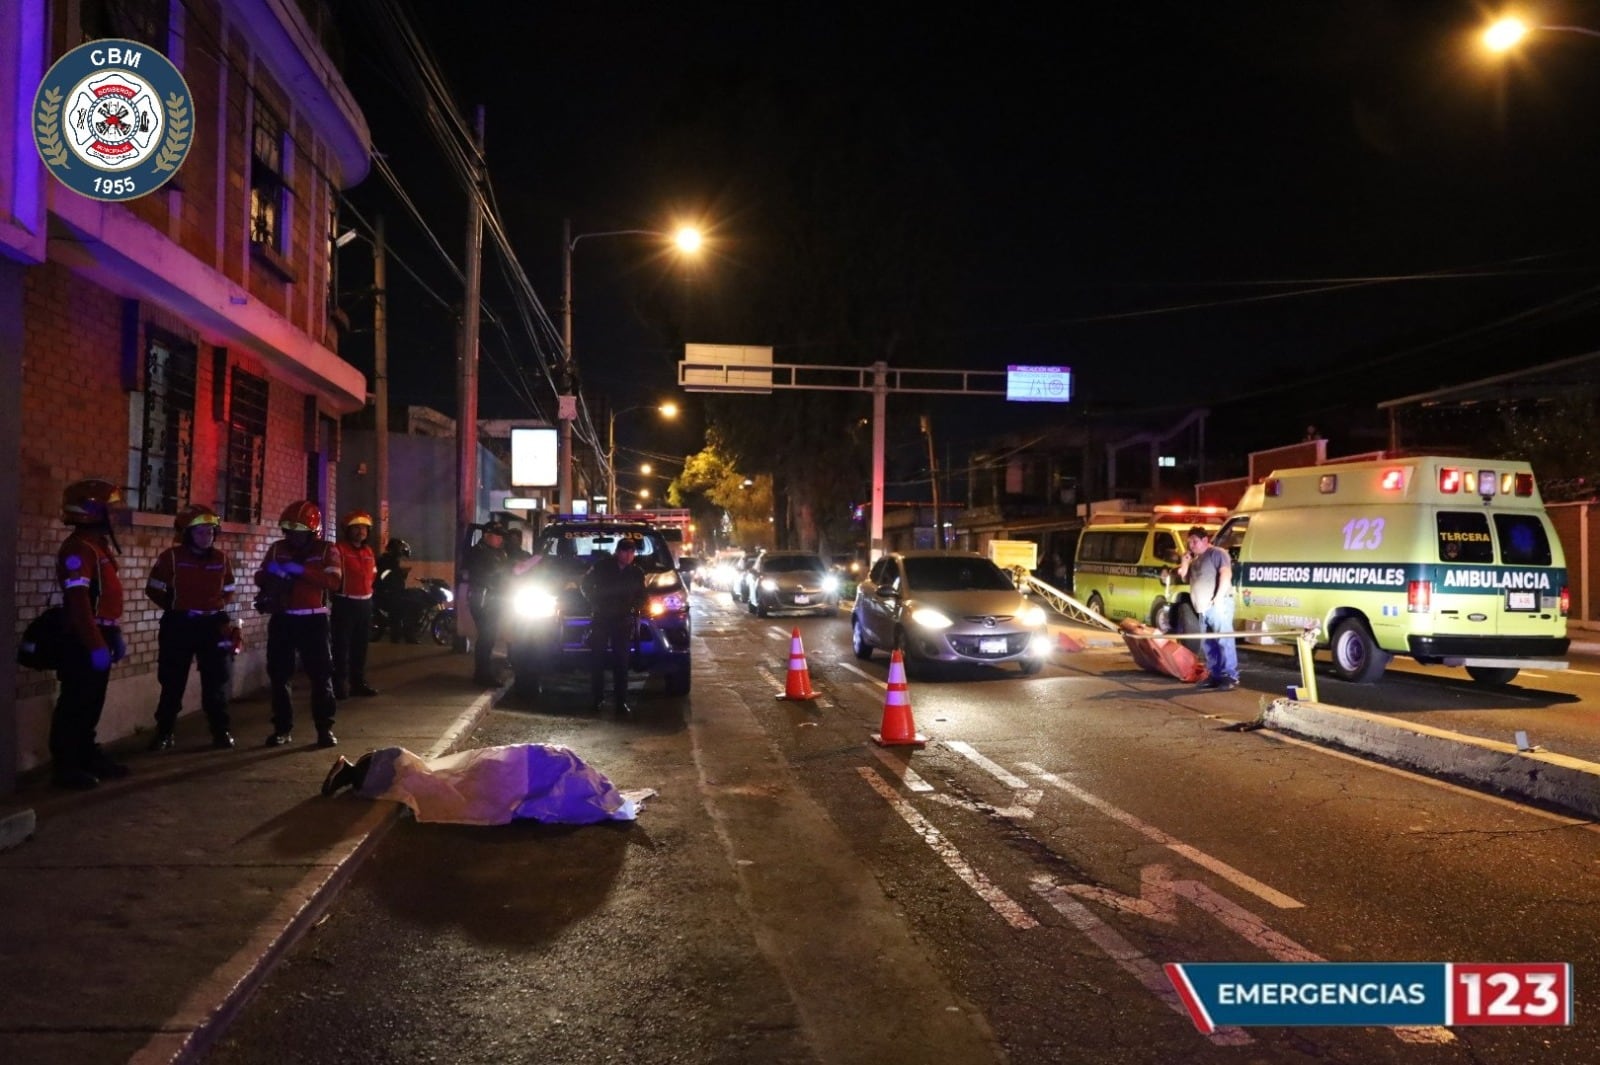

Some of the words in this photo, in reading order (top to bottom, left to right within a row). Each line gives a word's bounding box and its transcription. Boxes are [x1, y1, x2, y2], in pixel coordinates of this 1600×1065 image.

[1342, 517, 1385, 550] 123
[1440, 532, 1490, 542] TERCERA
[1249, 566, 1310, 582] BOMBEROS
[1312, 567, 1405, 586] MUNICIPALES
[1443, 569, 1550, 589] AMBULANCIA
